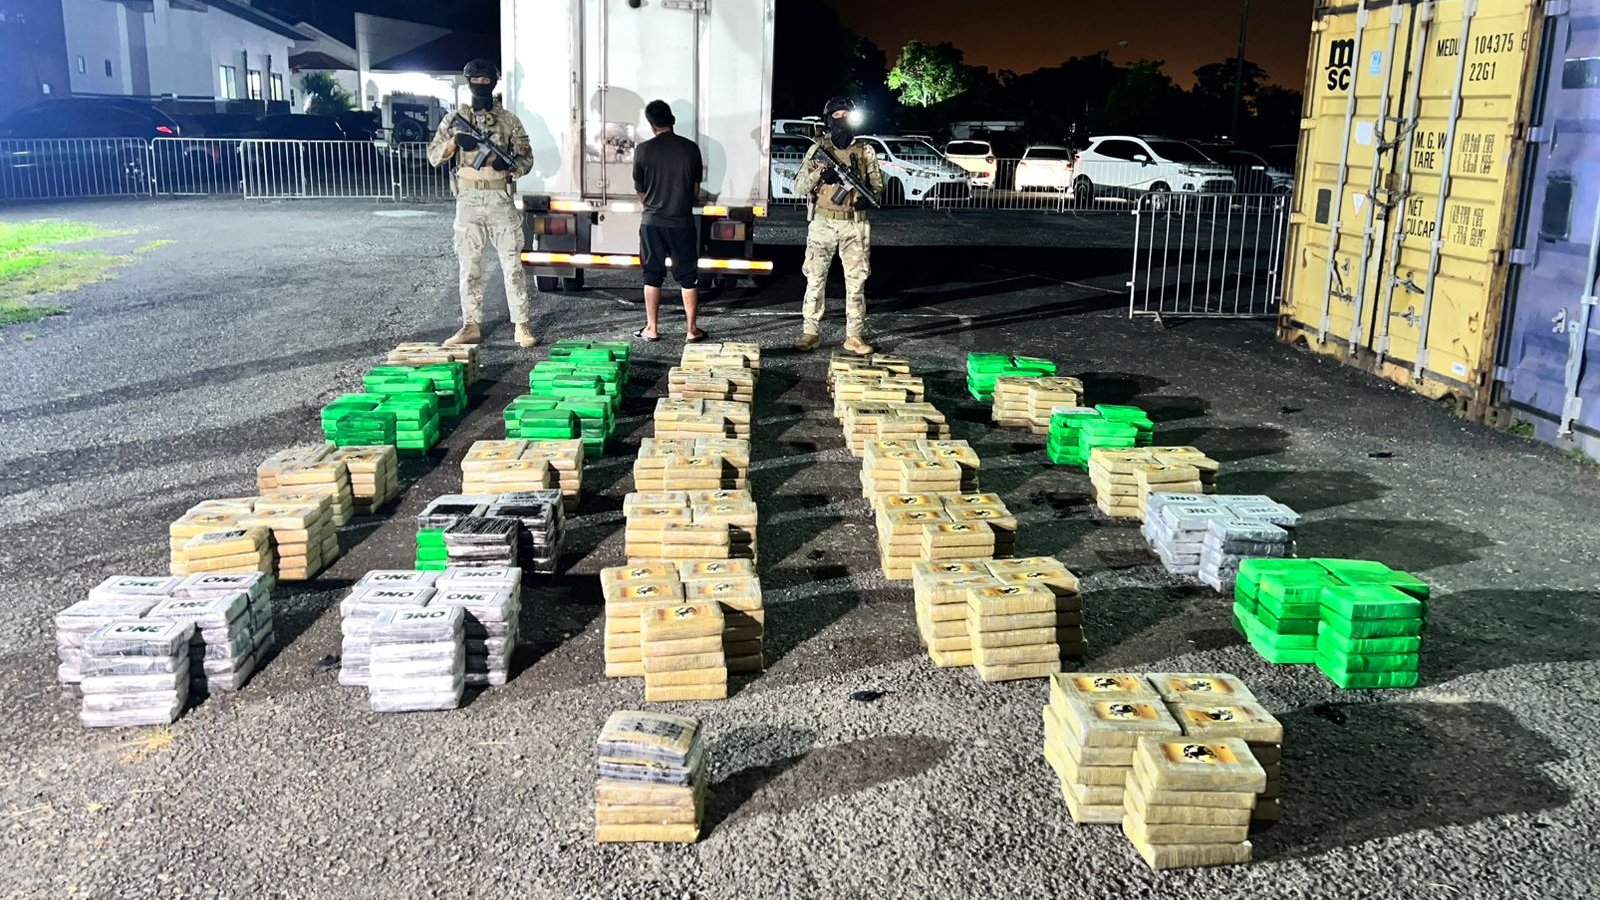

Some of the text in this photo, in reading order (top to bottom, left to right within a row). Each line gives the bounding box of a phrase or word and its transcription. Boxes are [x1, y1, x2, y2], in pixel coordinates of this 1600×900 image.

[1436, 38, 1461, 57] MEDU
[1475, 33, 1515, 54] 104375
[1469, 62, 1497, 82] 22G1
[1414, 151, 1435, 169] TARE
[1408, 199, 1424, 217] NET
[374, 573, 417, 581] ONE
[446, 593, 489, 601] ONE
[400, 611, 446, 621] ONE
[114, 625, 167, 633] ONE
